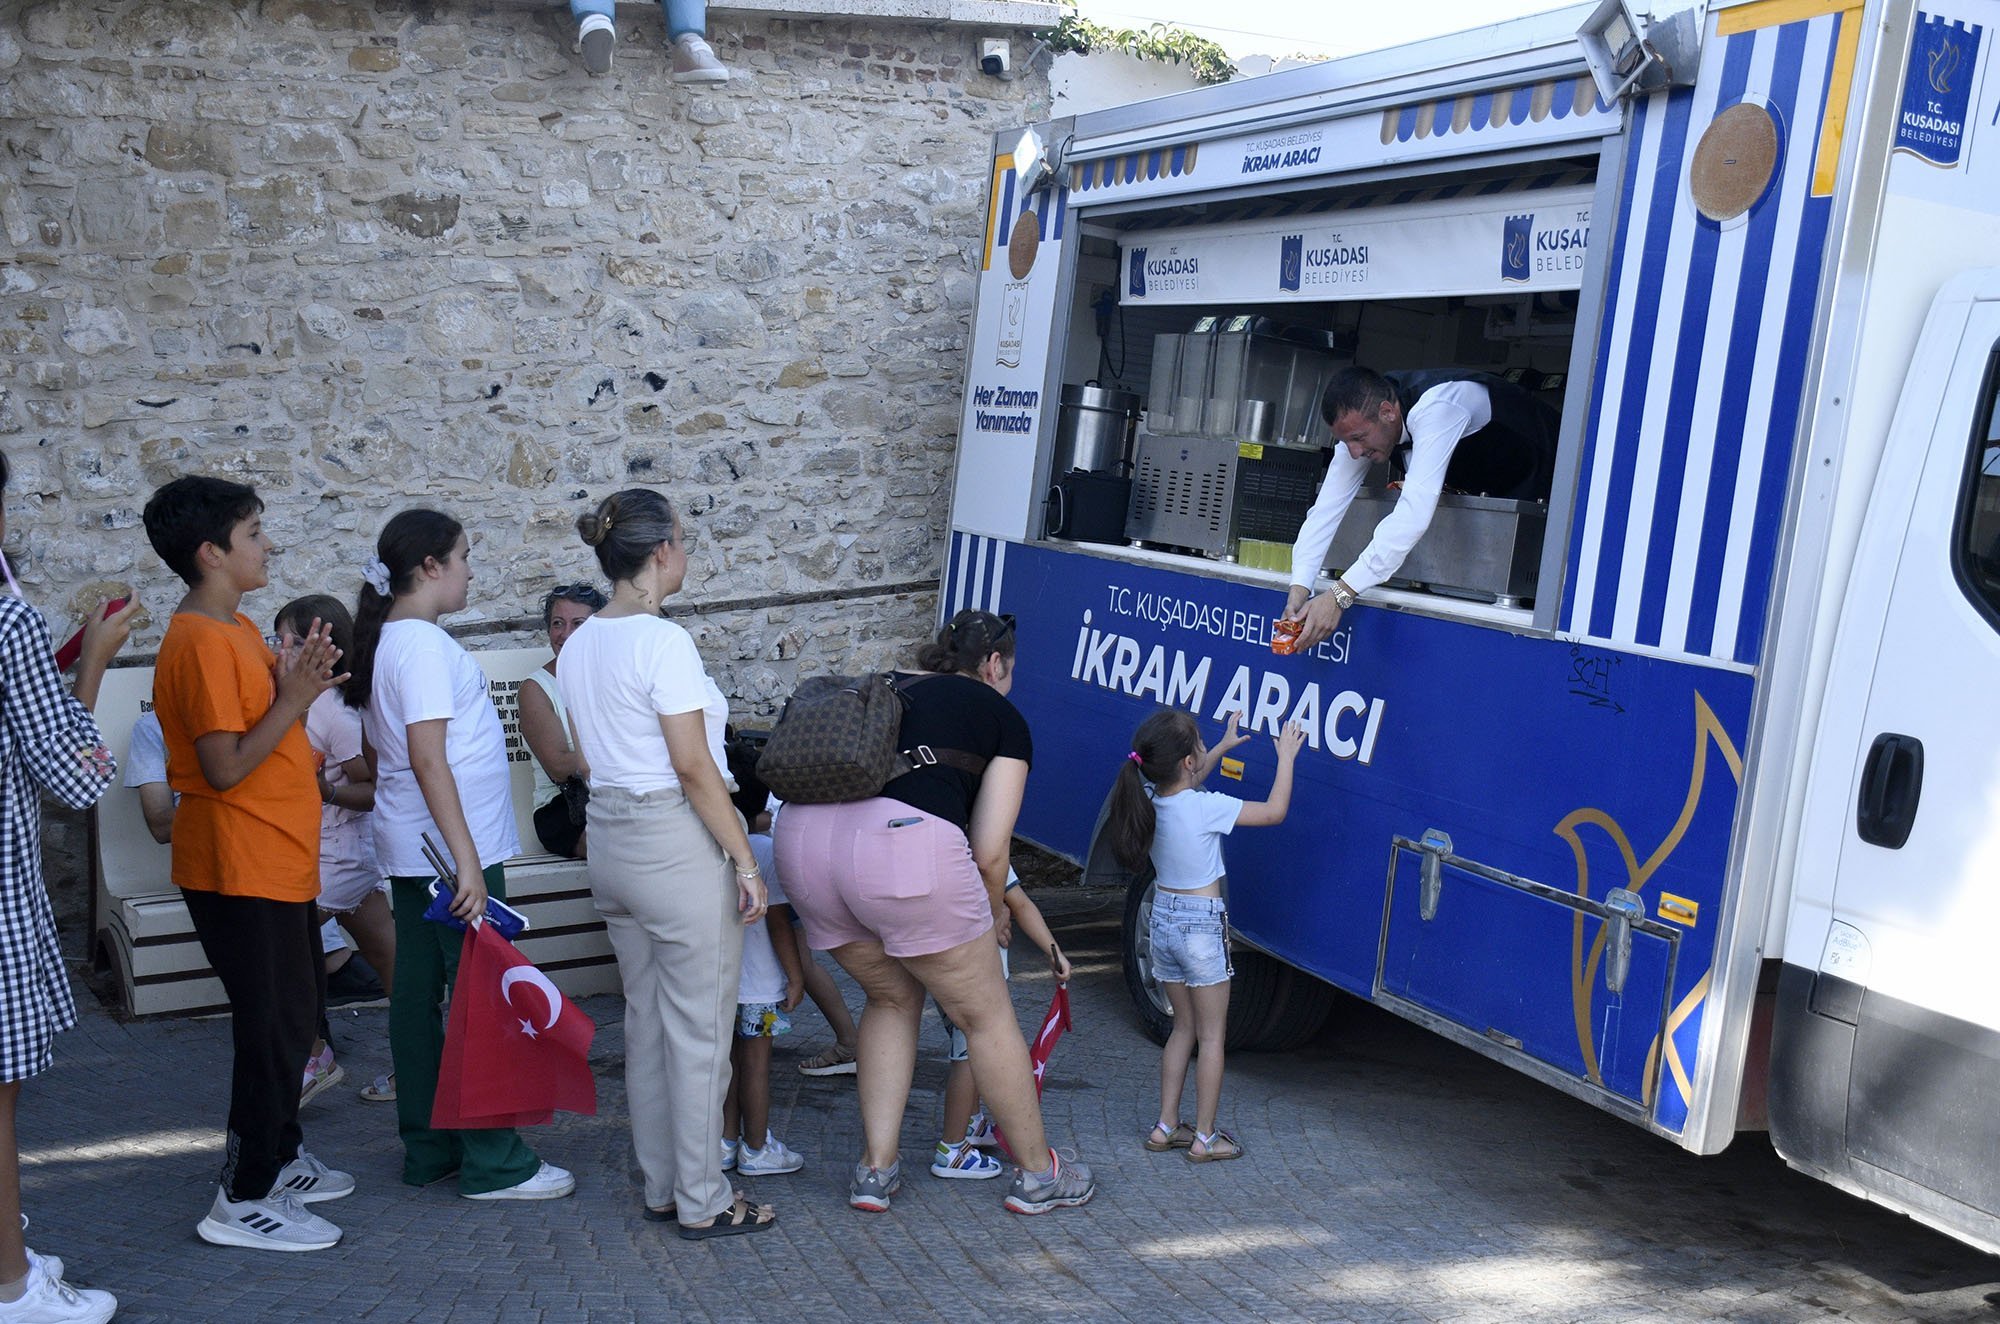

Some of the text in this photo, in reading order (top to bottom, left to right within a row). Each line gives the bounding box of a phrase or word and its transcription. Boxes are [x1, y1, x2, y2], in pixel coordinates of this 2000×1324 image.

[1927, 101, 1943, 114] T.C.
[1902, 112, 1960, 135] KUŞADASI
[1900, 128, 1958, 148] BELEDİYESİ
[1241, 146, 1321, 174] İKRAM ARACI
[1576, 211, 1589, 222] T.C.
[1306, 246, 1369, 267] KUŞADASI
[1147, 258, 1199, 276] KUŞADASI
[1304, 267, 1369, 284] BELEDİYESİ
[1148, 277, 1199, 291] BELEDİYESİ
[973, 385, 1039, 409] Her Zaman
[975, 410, 1032, 433] Yanınızda
[1108, 585, 1132, 617] T.C.
[1135, 592, 1227, 637] KUŞADASI
[490, 680, 506, 691] Ama
[1071, 608, 1385, 765] İKRAM ARACI
